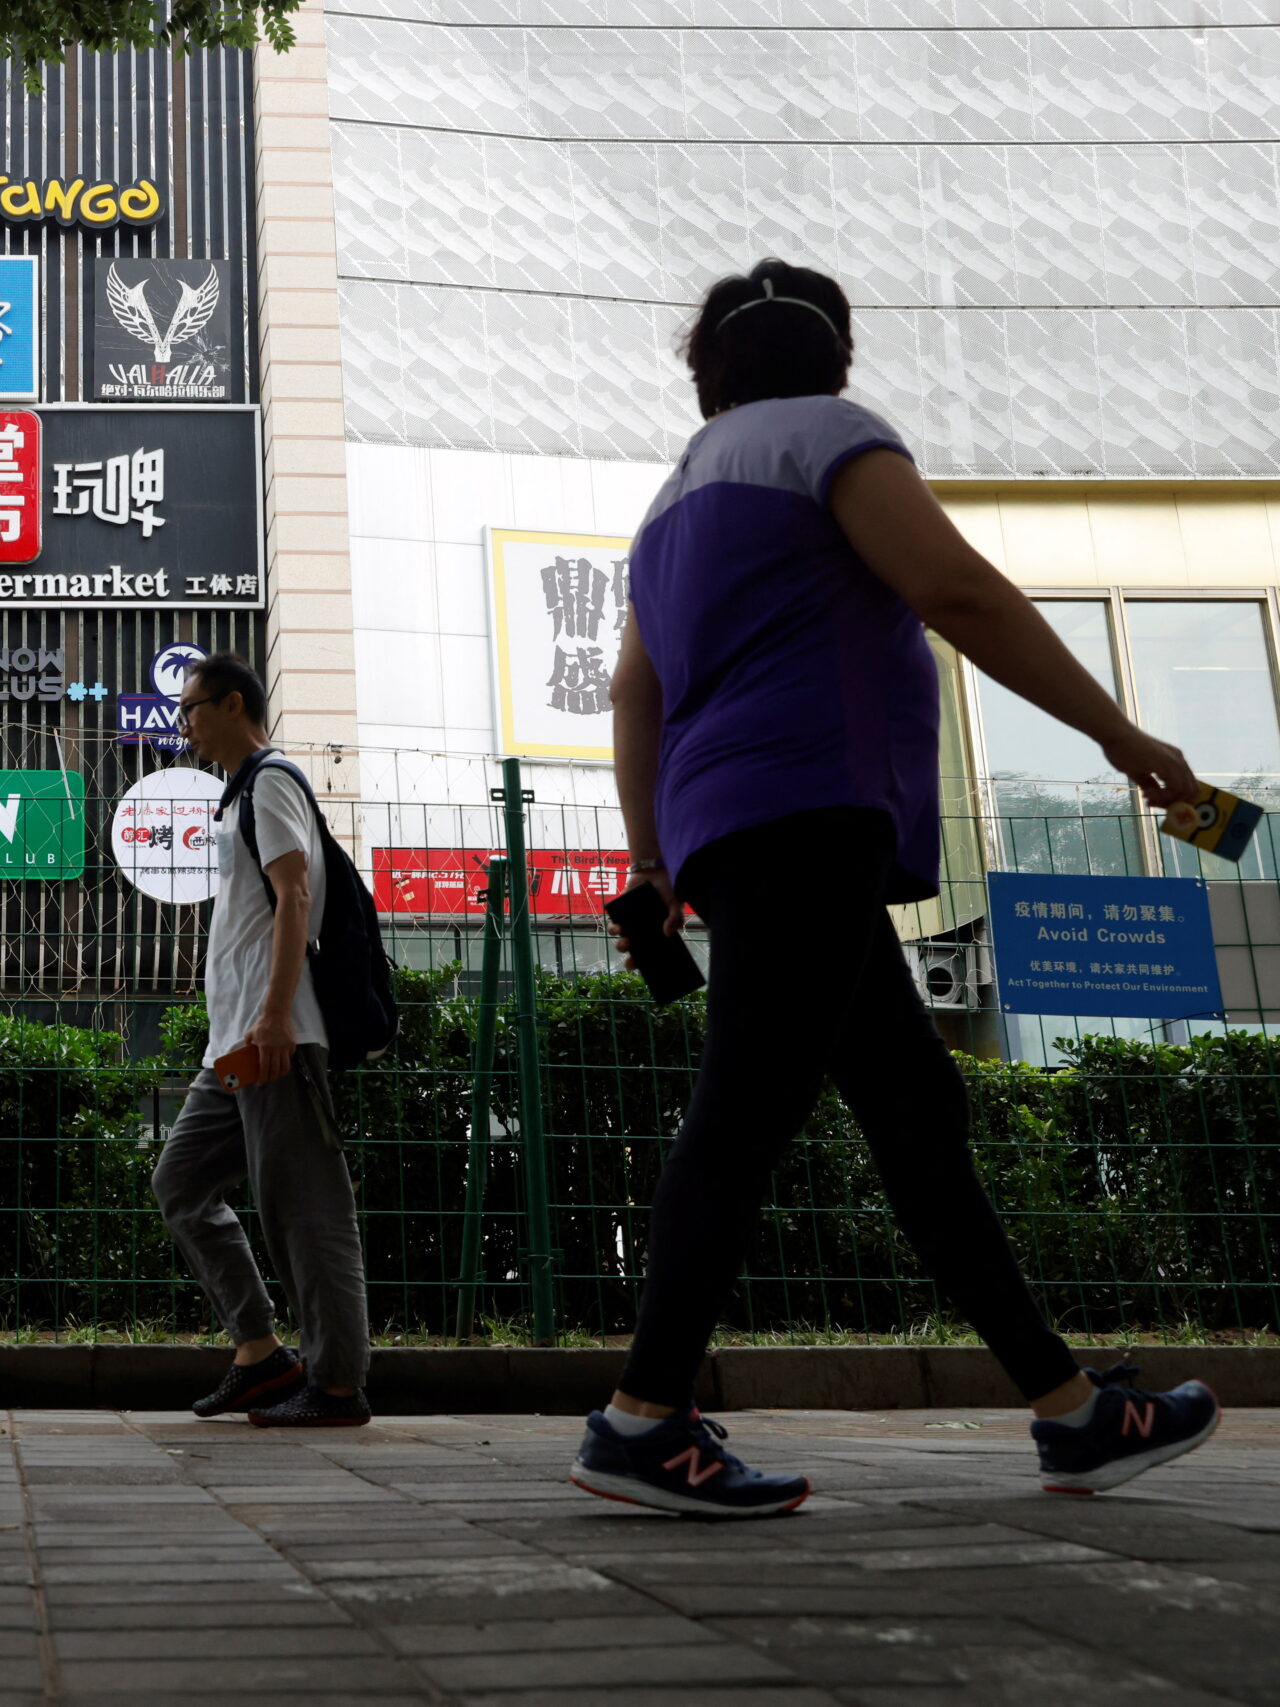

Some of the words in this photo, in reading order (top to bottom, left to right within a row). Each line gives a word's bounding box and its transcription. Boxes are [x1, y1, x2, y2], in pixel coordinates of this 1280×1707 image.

[108, 363, 218, 386] VALHALLA
[184, 573, 258, 596] 工体店
[551, 855, 573, 864] The
[574, 855, 604, 865] Bird's
[550, 865, 632, 896] 小鸟
[1014, 901, 1185, 923] 疫情期间，请勿聚集。
[1037, 926, 1089, 943] Avoid
[1096, 928, 1167, 945] Crowds
[1008, 978, 1025, 988] Act
[1025, 979, 1070, 991] Together
[1071, 981, 1083, 990] to
[1084, 981, 1121, 991] Protect
[1122, 982, 1142, 992] Our
[1143, 982, 1209, 994] Environment
